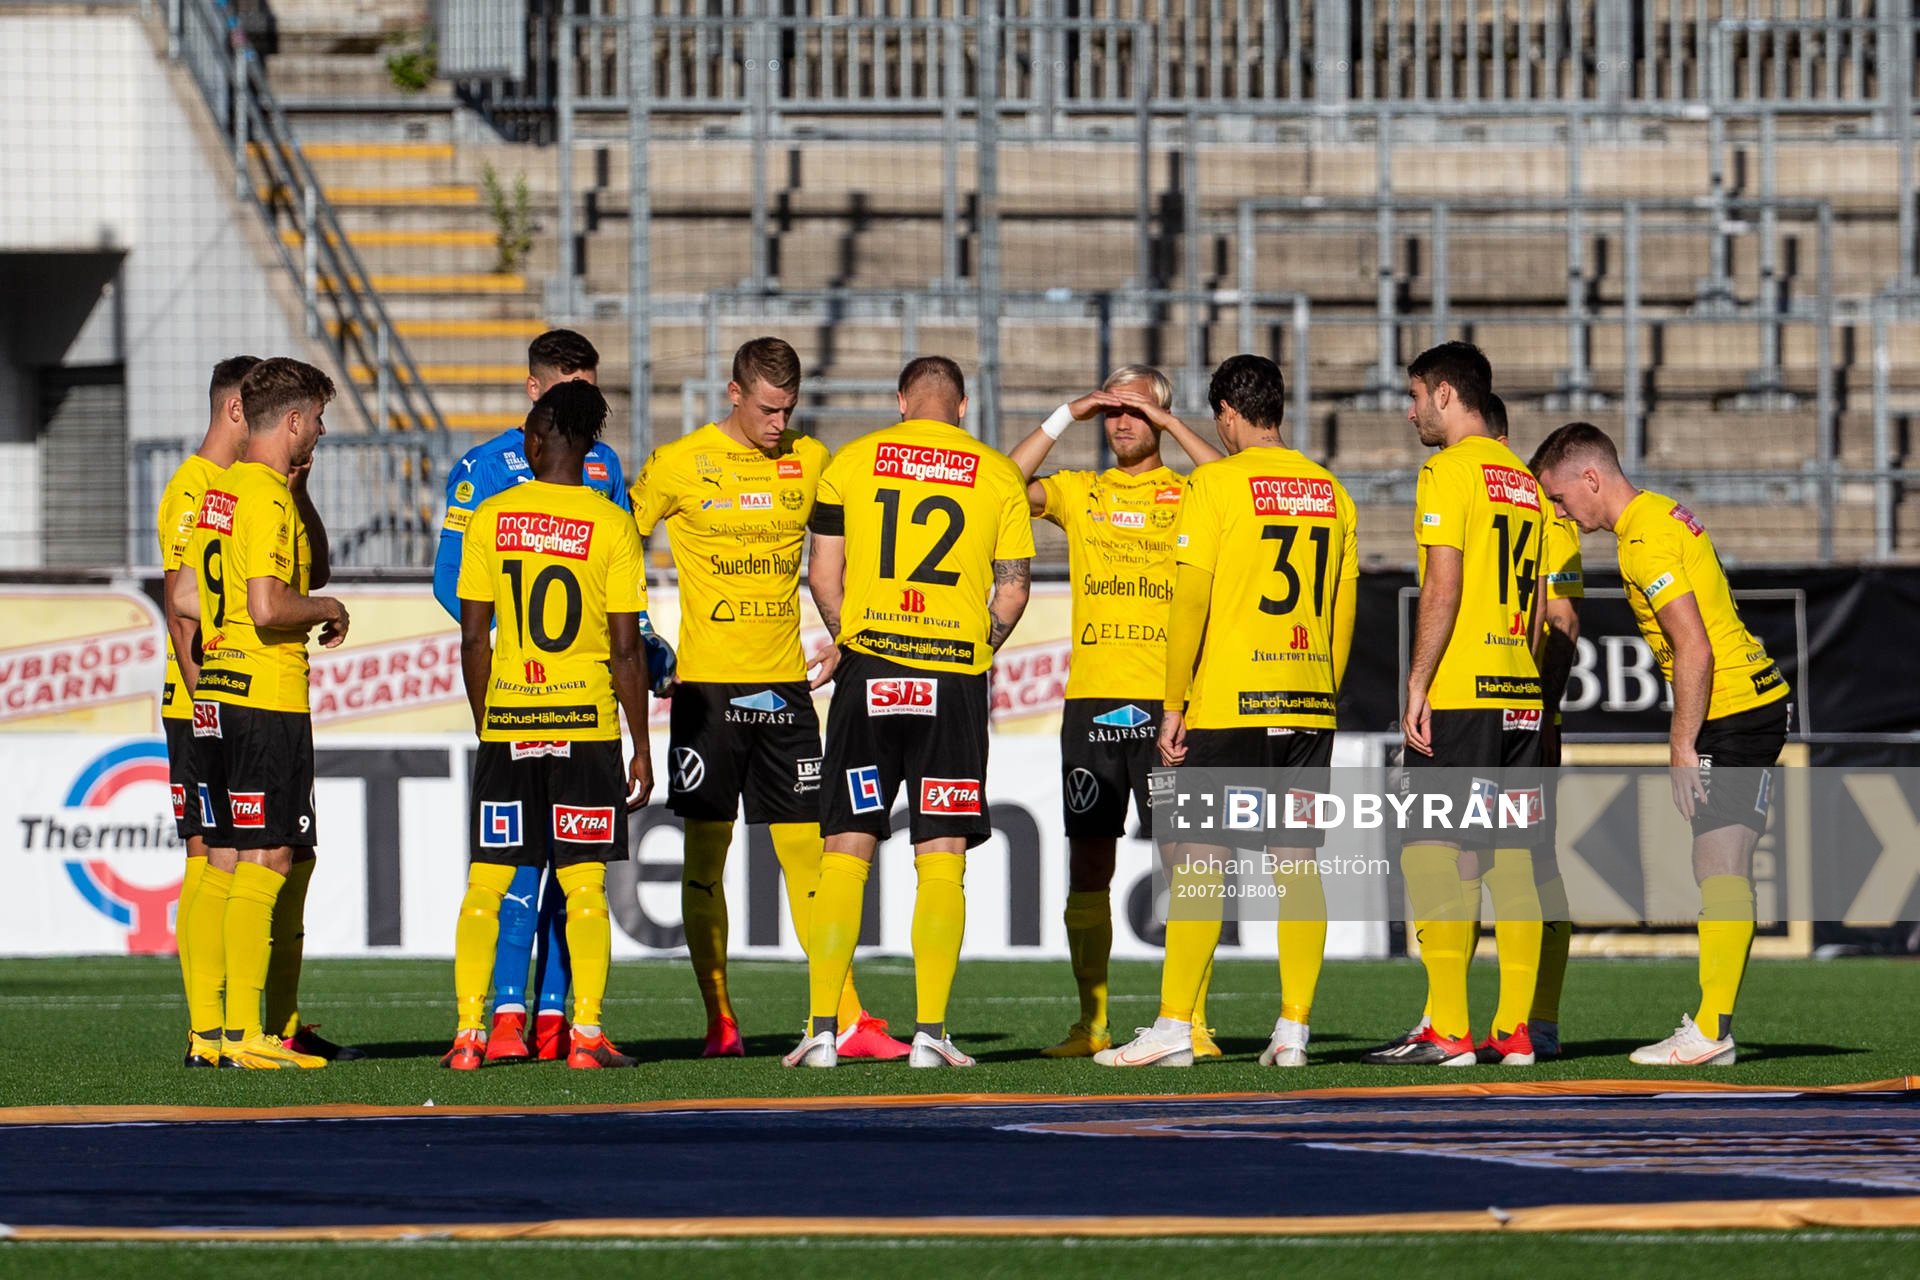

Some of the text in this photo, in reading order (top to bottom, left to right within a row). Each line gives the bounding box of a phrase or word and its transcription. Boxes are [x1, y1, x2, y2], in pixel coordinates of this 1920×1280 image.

[879, 445, 976, 471] marching
[876, 459, 898, 473] on
[901, 459, 963, 481] together
[1252, 478, 1333, 498] marching
[1488, 485, 1505, 498] on
[1255, 496, 1276, 511] on
[1276, 494, 1328, 515] together
[499, 516, 590, 541] marching
[874, 488, 966, 587] 12
[497, 533, 518, 546] on
[521, 529, 577, 552] together
[711, 552, 770, 576] Sweden
[1258, 525, 1330, 617] 31
[1492, 514, 1536, 612] 14
[203, 539, 226, 628] 9
[1084, 573, 1174, 601] Sweden Rock
[502, 560, 582, 653] 10
[1101, 623, 1168, 642] ELEDA
[0, 672, 117, 709] GARN
[724, 709, 796, 724] SÄLJFAST
[1088, 726, 1157, 742] SÄLJFAST
[926, 786, 979, 807] EXTRA
[19, 814, 184, 850] Thermia
[299, 816, 311, 833] 9
[560, 812, 608, 835] EXTRA
